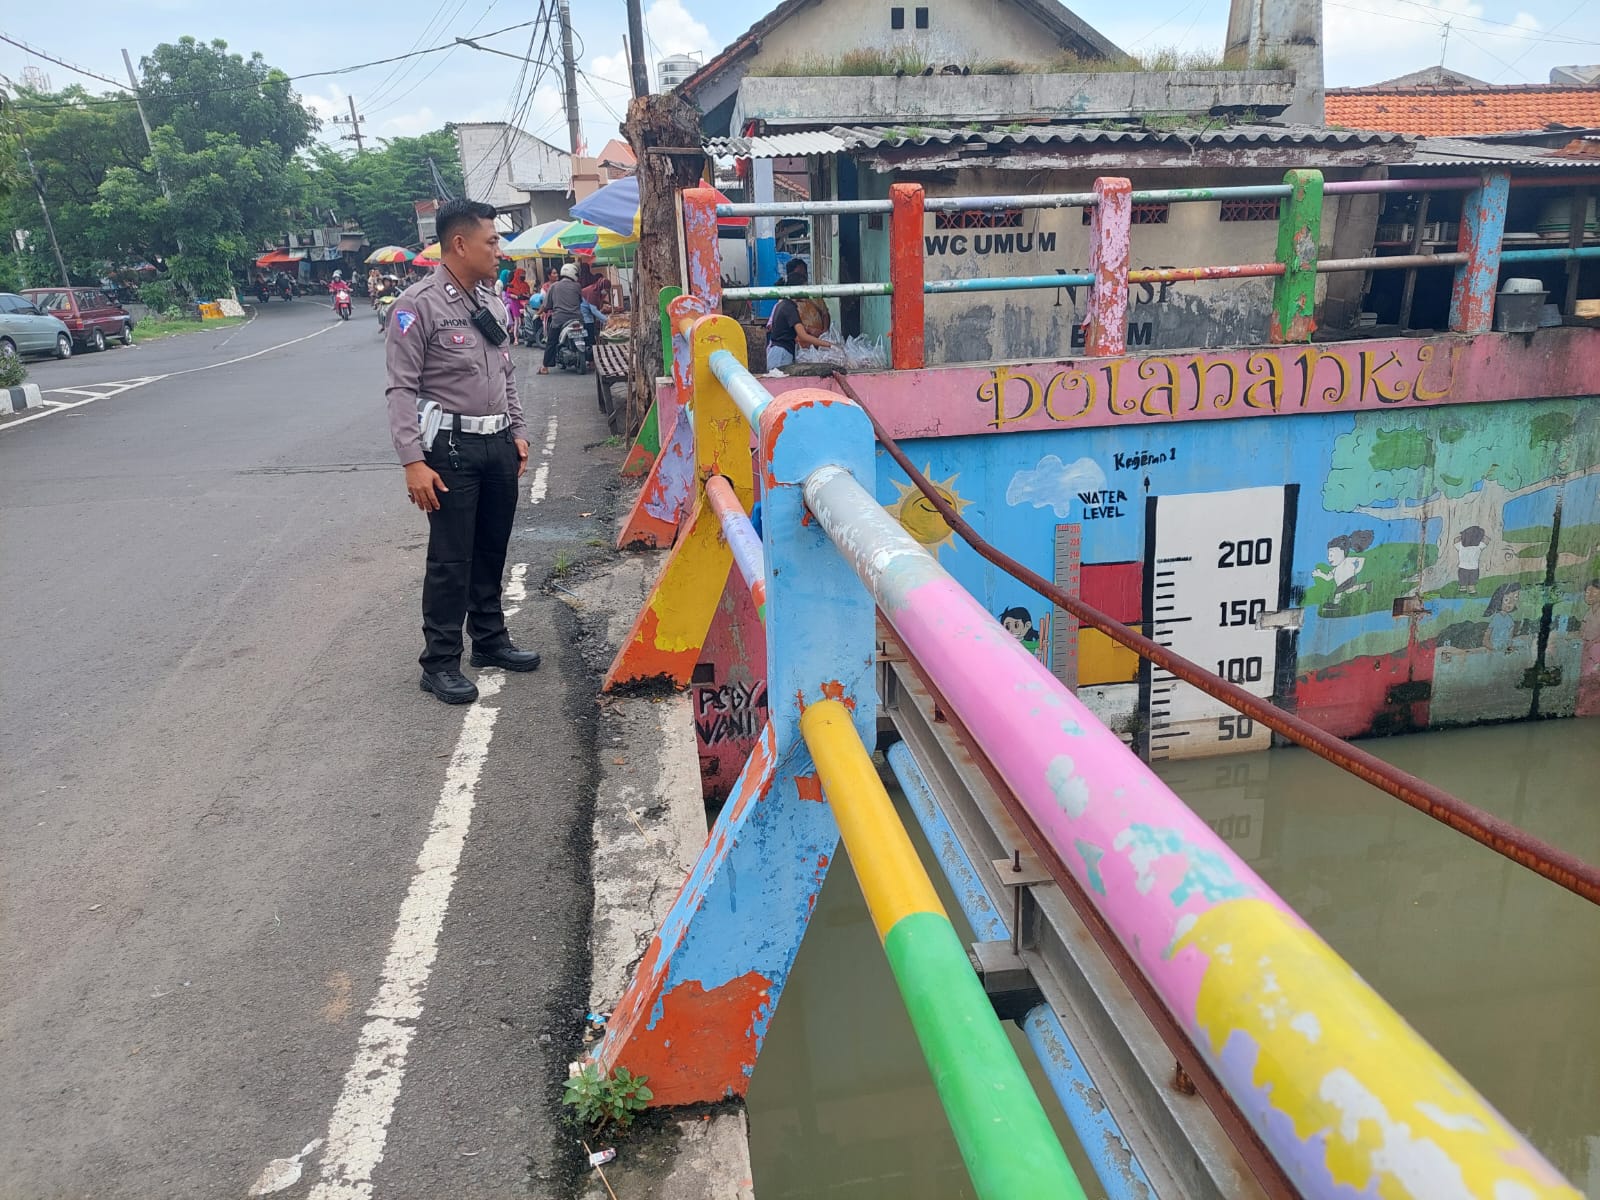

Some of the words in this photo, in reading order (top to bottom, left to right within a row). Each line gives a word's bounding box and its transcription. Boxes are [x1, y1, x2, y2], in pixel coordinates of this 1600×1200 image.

[925, 235, 967, 256] WC
[974, 232, 1056, 255] UMUM
[439, 318, 468, 327] JHONI
[1169, 447, 1176, 460] 1
[1077, 490, 1128, 505] WATER
[1083, 506, 1126, 520] LEVEL
[1217, 537, 1273, 568] 200
[1219, 598, 1266, 627] 150
[1217, 656, 1263, 684] 100
[1218, 716, 1254, 742] 50
